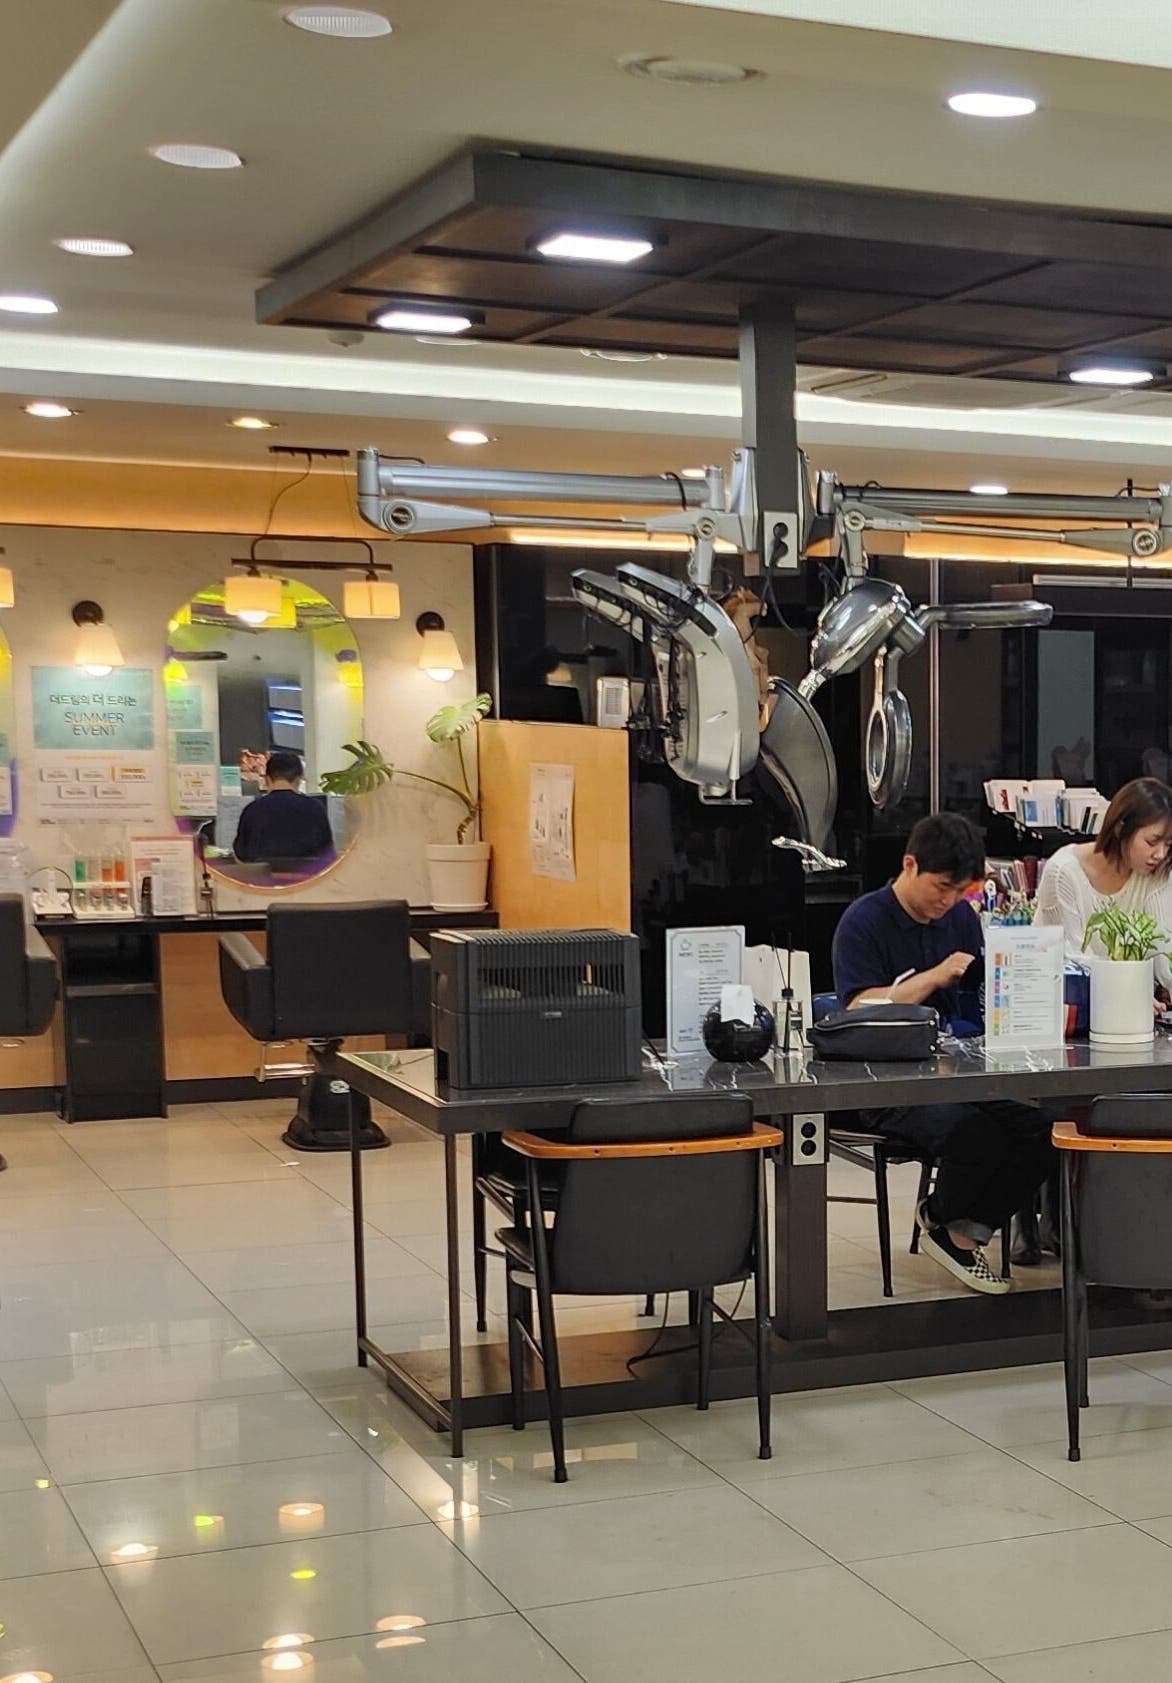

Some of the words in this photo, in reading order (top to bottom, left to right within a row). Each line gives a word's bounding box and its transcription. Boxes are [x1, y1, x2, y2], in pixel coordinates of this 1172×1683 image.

[92, 693, 104, 706] 더
[107, 694, 137, 707] 드리는
[64, 711, 125, 723] SUMMER
[73, 724, 117, 736] EVENT
